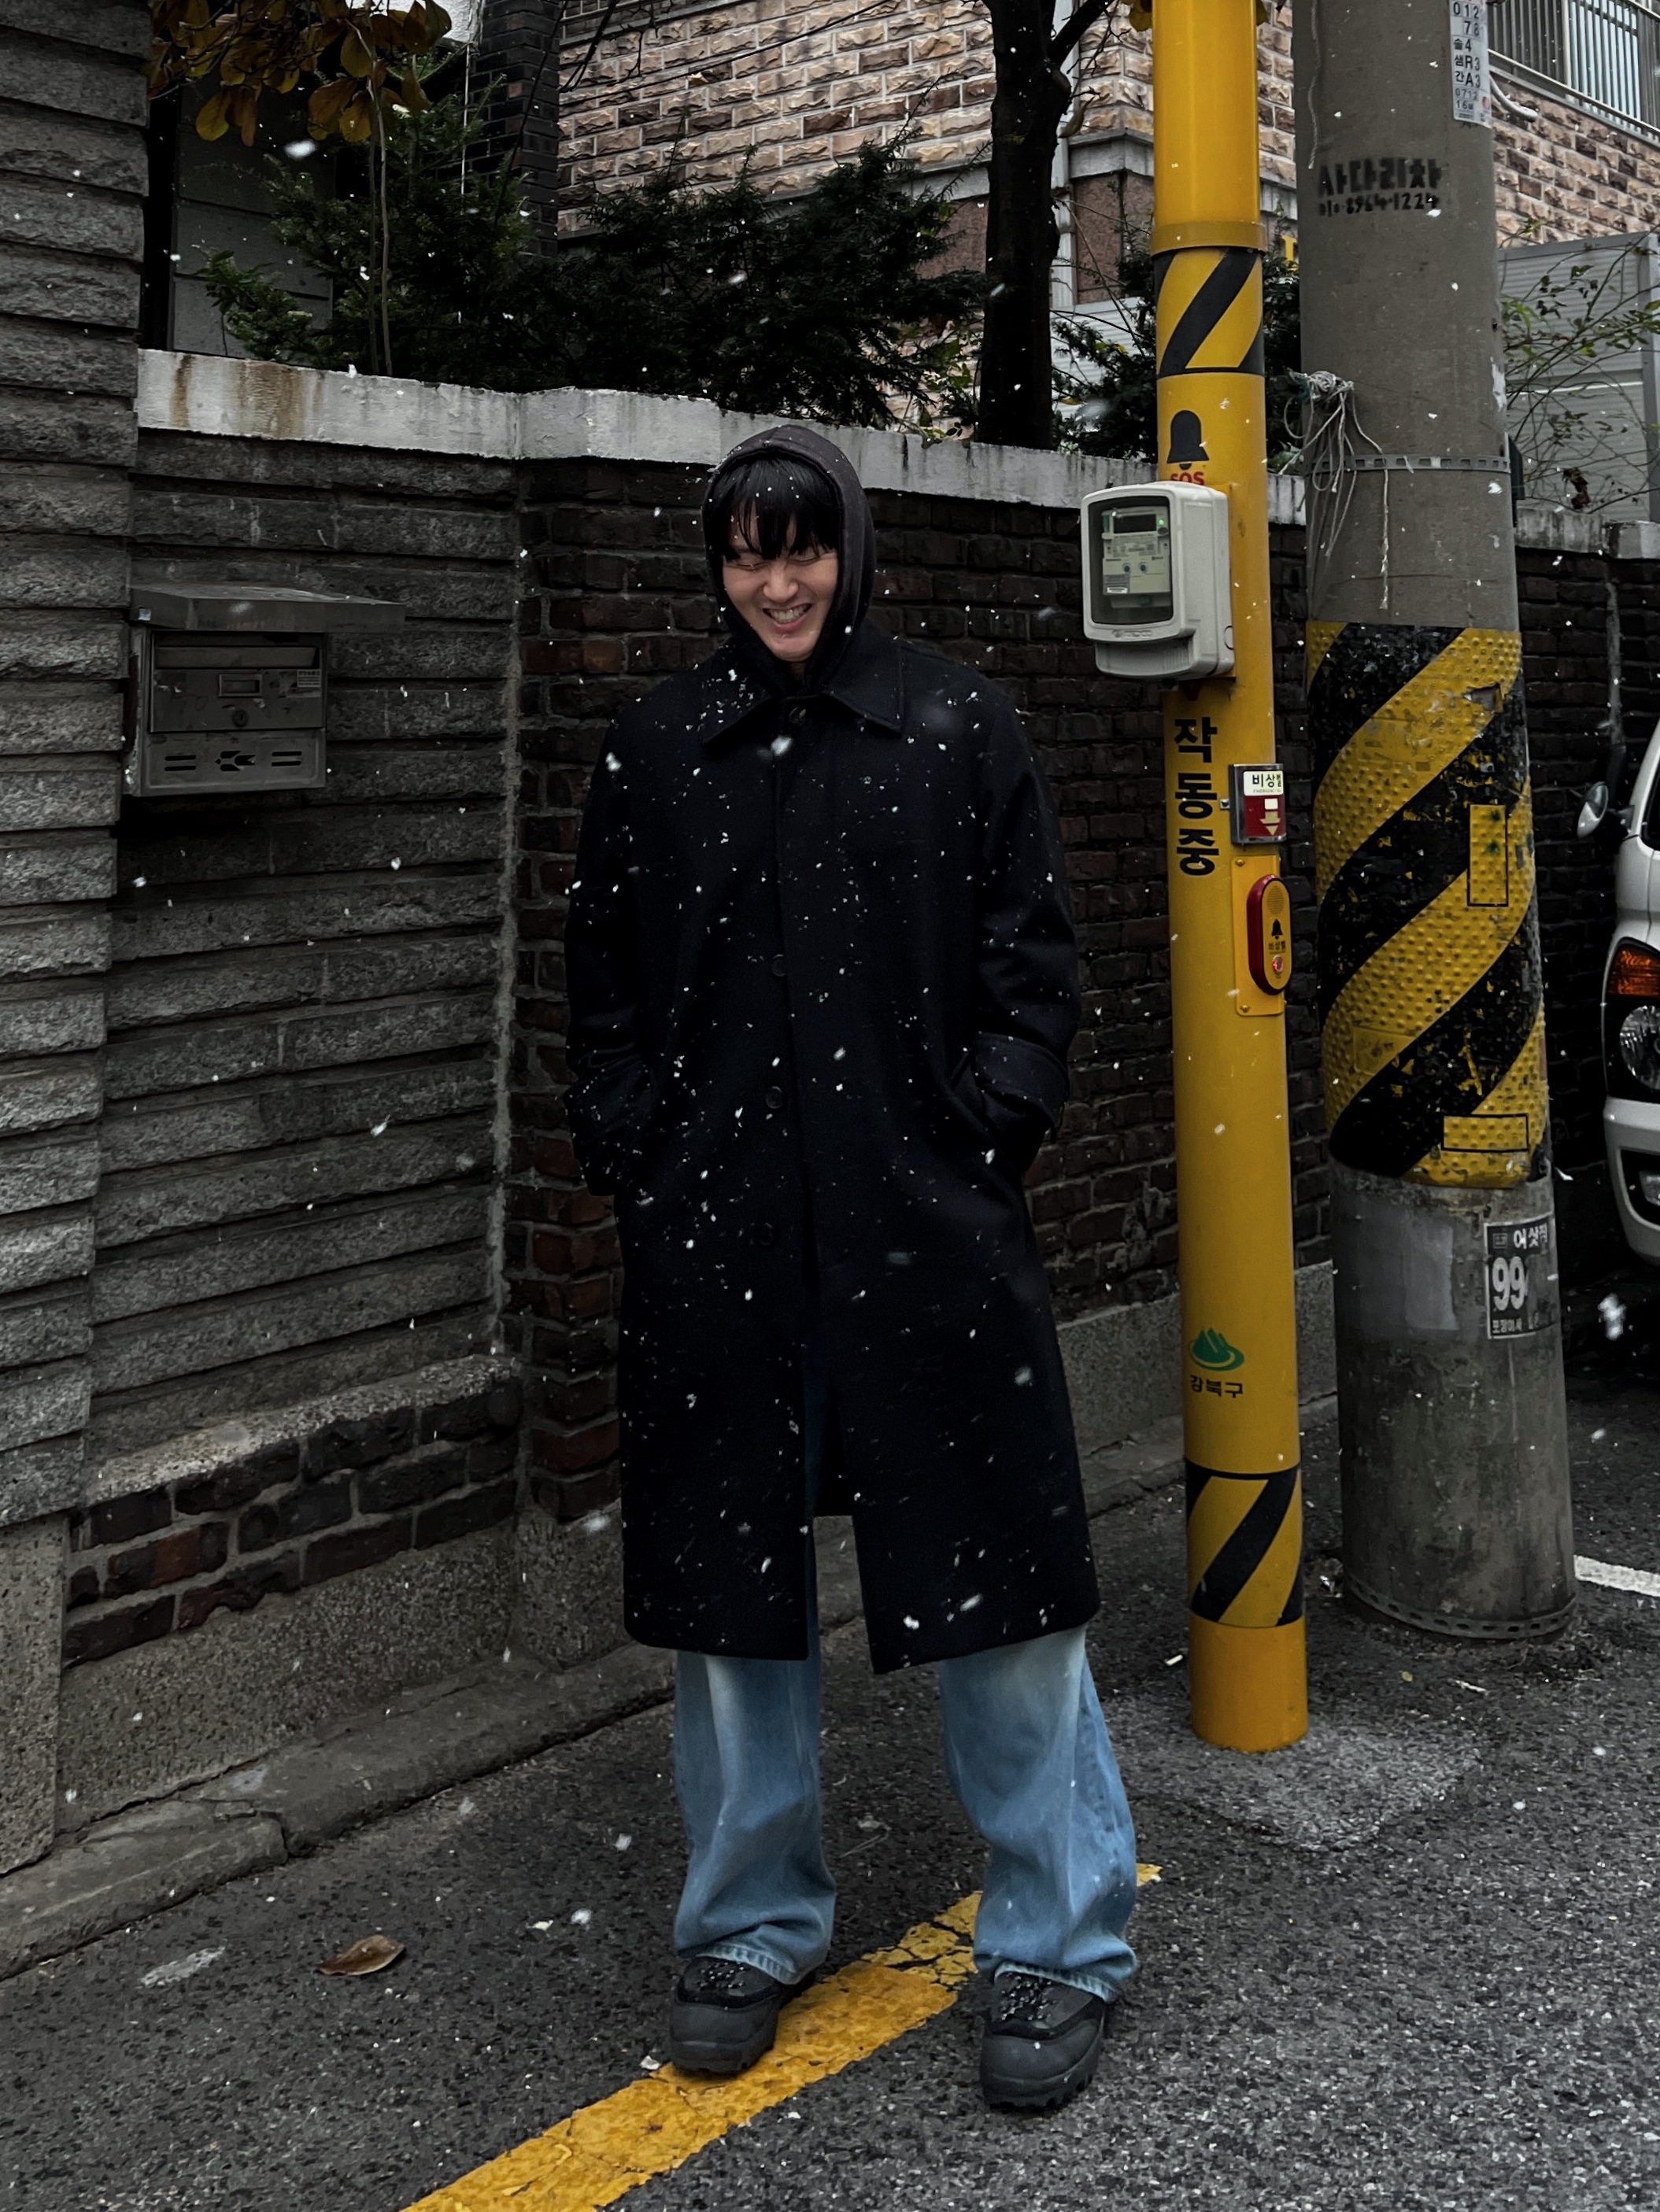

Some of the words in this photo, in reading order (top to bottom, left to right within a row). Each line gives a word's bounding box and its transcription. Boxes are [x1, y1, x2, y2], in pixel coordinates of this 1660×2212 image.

[1318, 158, 1442, 195] 사다리차
[1174, 717, 1219, 876] 작동중
[1492, 1257, 1529, 1311] 99
[1190, 1375, 1243, 1398] 강북구
